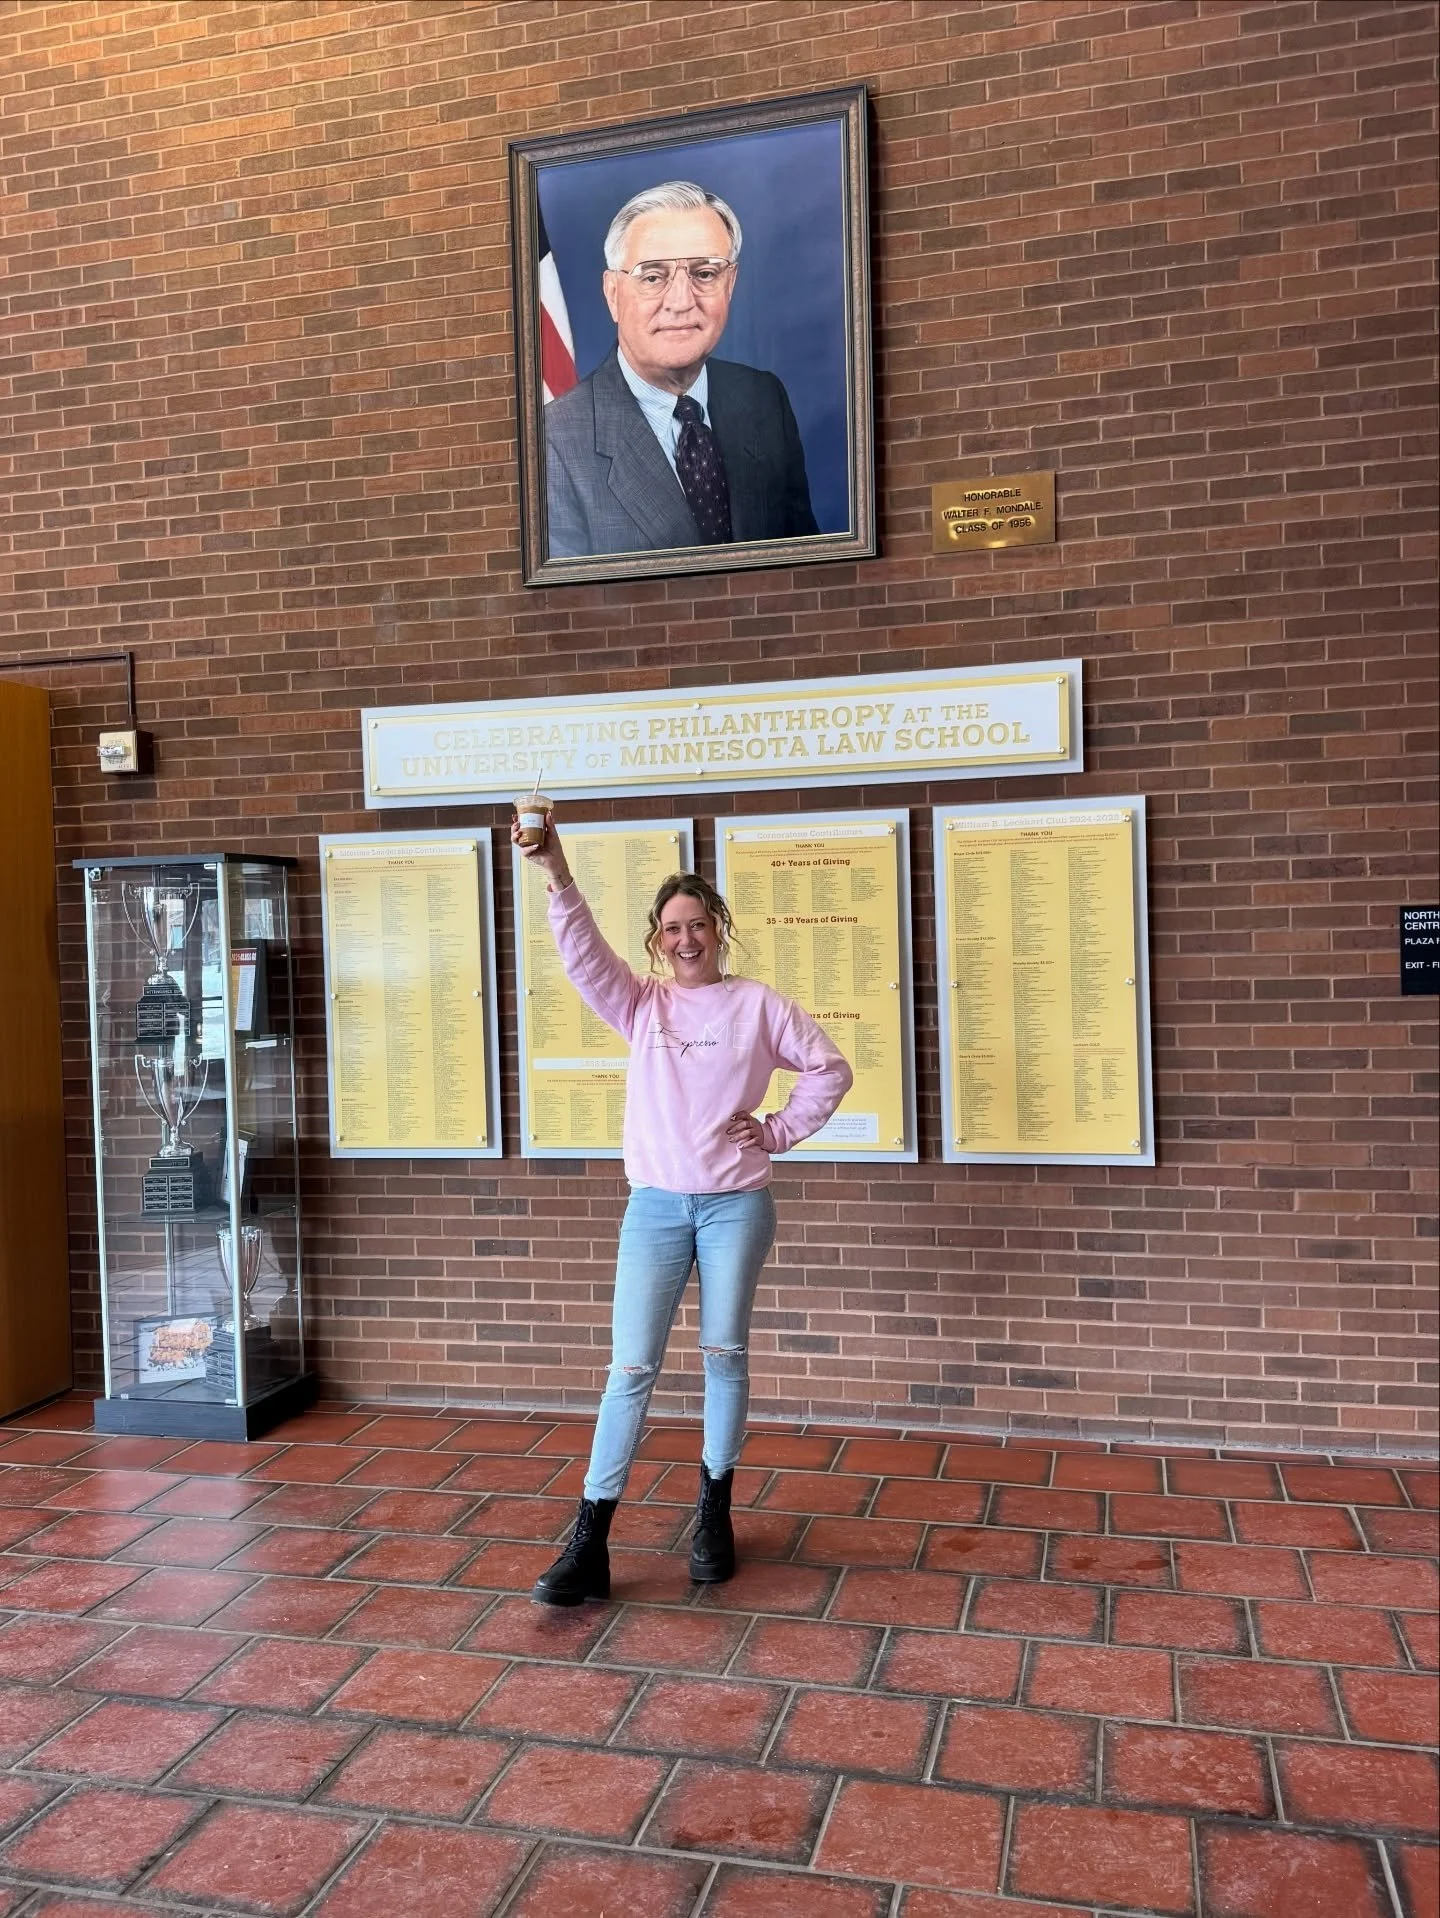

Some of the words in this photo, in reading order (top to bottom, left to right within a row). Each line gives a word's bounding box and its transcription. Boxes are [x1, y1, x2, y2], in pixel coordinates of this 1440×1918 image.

[963, 488, 1021, 501] HONORABLE
[943, 508, 979, 519] WALTER
[955, 522, 987, 534] CLASS
[991, 521, 1005, 530] OF
[1009, 518, 1032, 528] 1956
[433, 719, 640, 750] CELEBRATING
[648, 703, 895, 739] PHILANTHROPY
[902, 707, 932, 723] AT
[941, 703, 990, 721] THE
[402, 748, 578, 777] UNIVERSITY
[585, 753, 611, 769] OF
[620, 735, 809, 766] MINNESOTA
[817, 730, 887, 756] LAW
[895, 721, 1031, 752] SCHOOL
[788, 859, 811, 867] Years
[812, 858, 821, 866] of
[822, 858, 850, 866] Giving
[766, 917, 777, 925] 35
[795, 916, 819, 924] Years
[820, 915, 829, 923] of
[830, 915, 858, 923] Giving
[1404, 911, 1440, 920] NORTH
[822, 1011, 831, 1019] of
[832, 1011, 861, 1020] Giving
